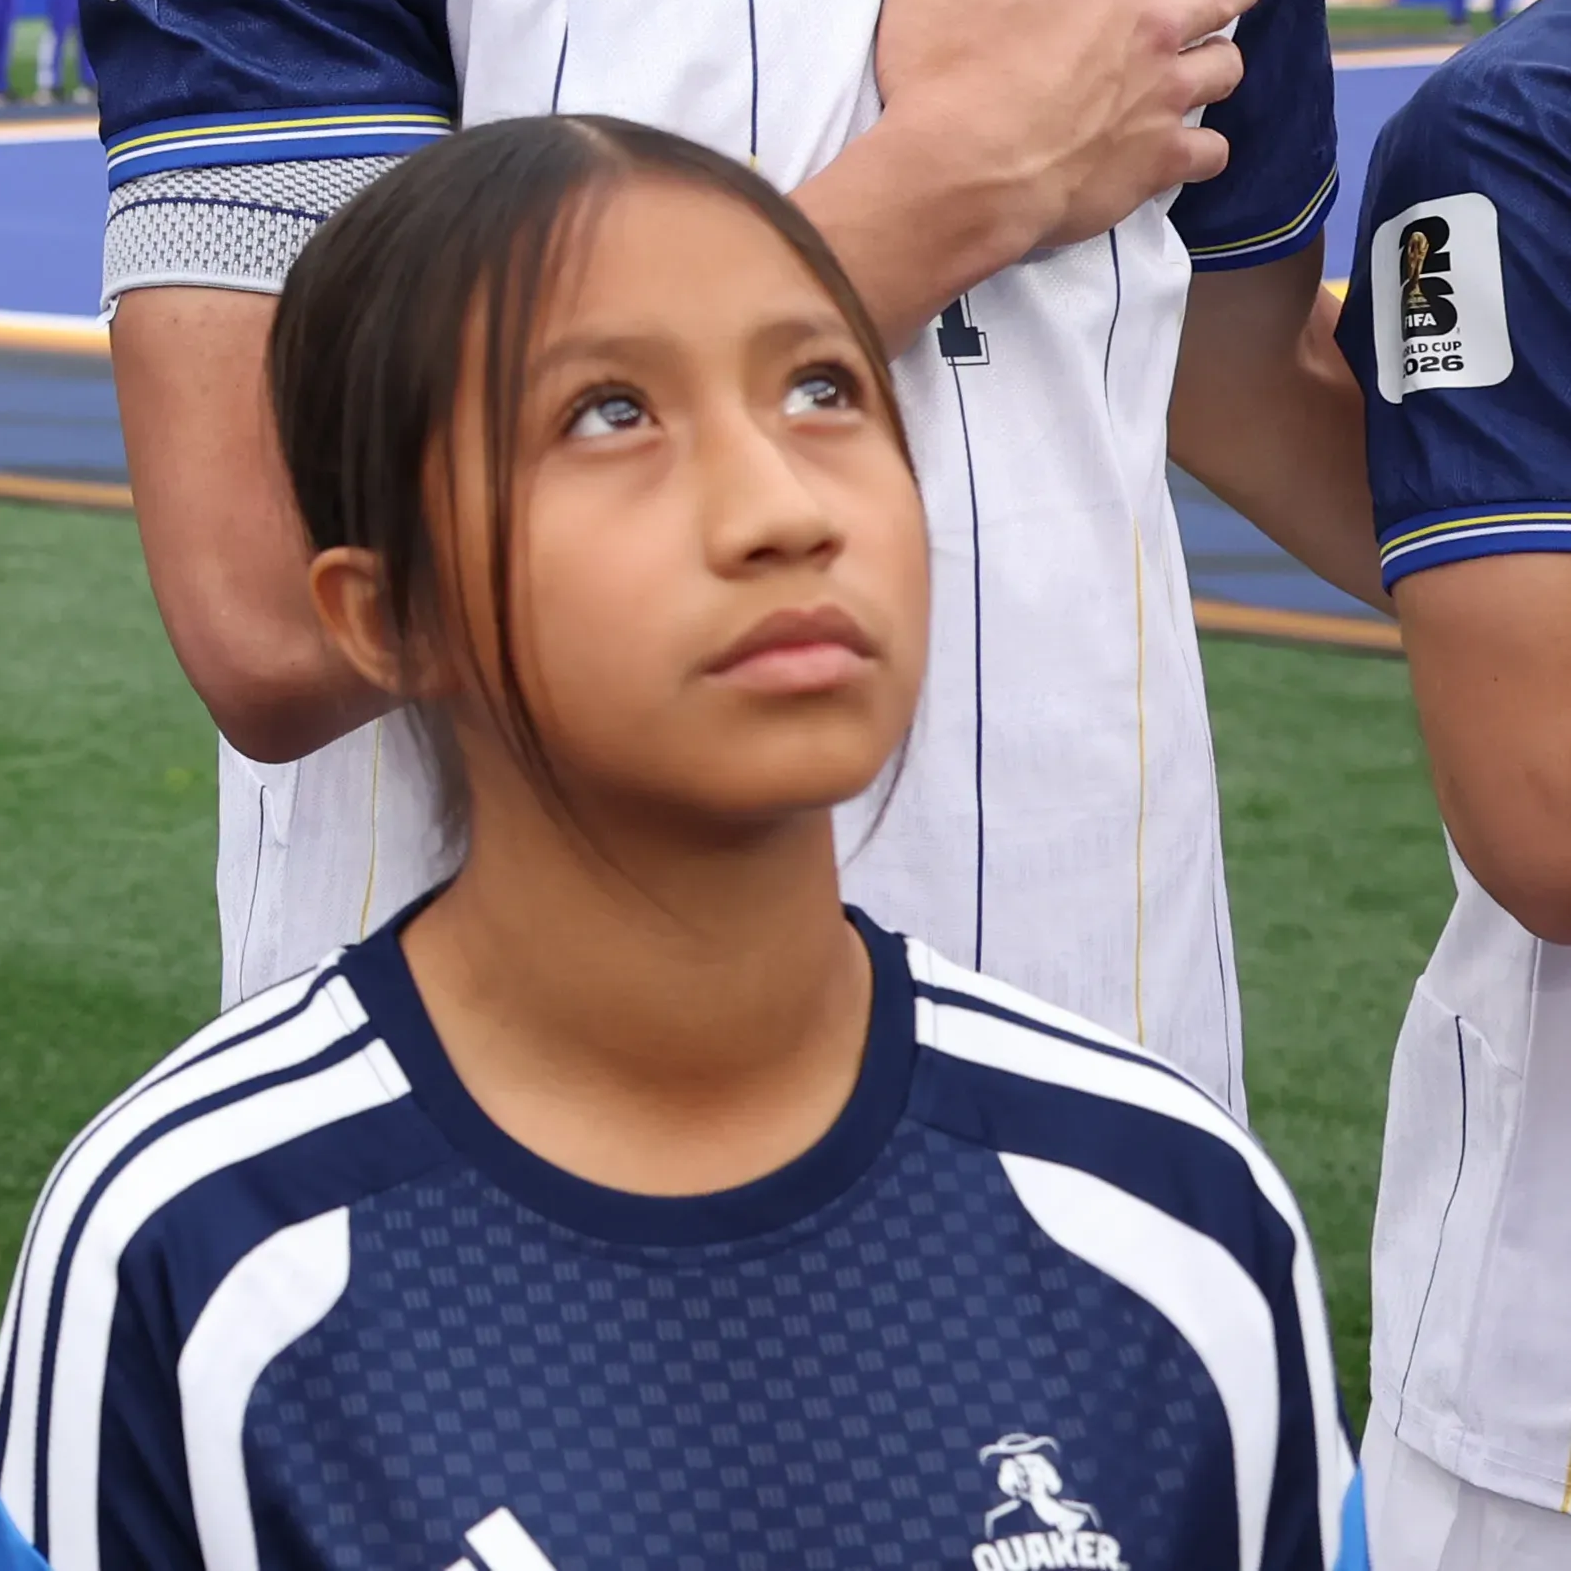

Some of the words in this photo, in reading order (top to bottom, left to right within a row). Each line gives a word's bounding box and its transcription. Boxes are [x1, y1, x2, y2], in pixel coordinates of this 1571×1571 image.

[1432, 340, 1462, 353] CUP
[1403, 354, 1465, 379] 026
[972, 1531, 1121, 1571] QUAKER
